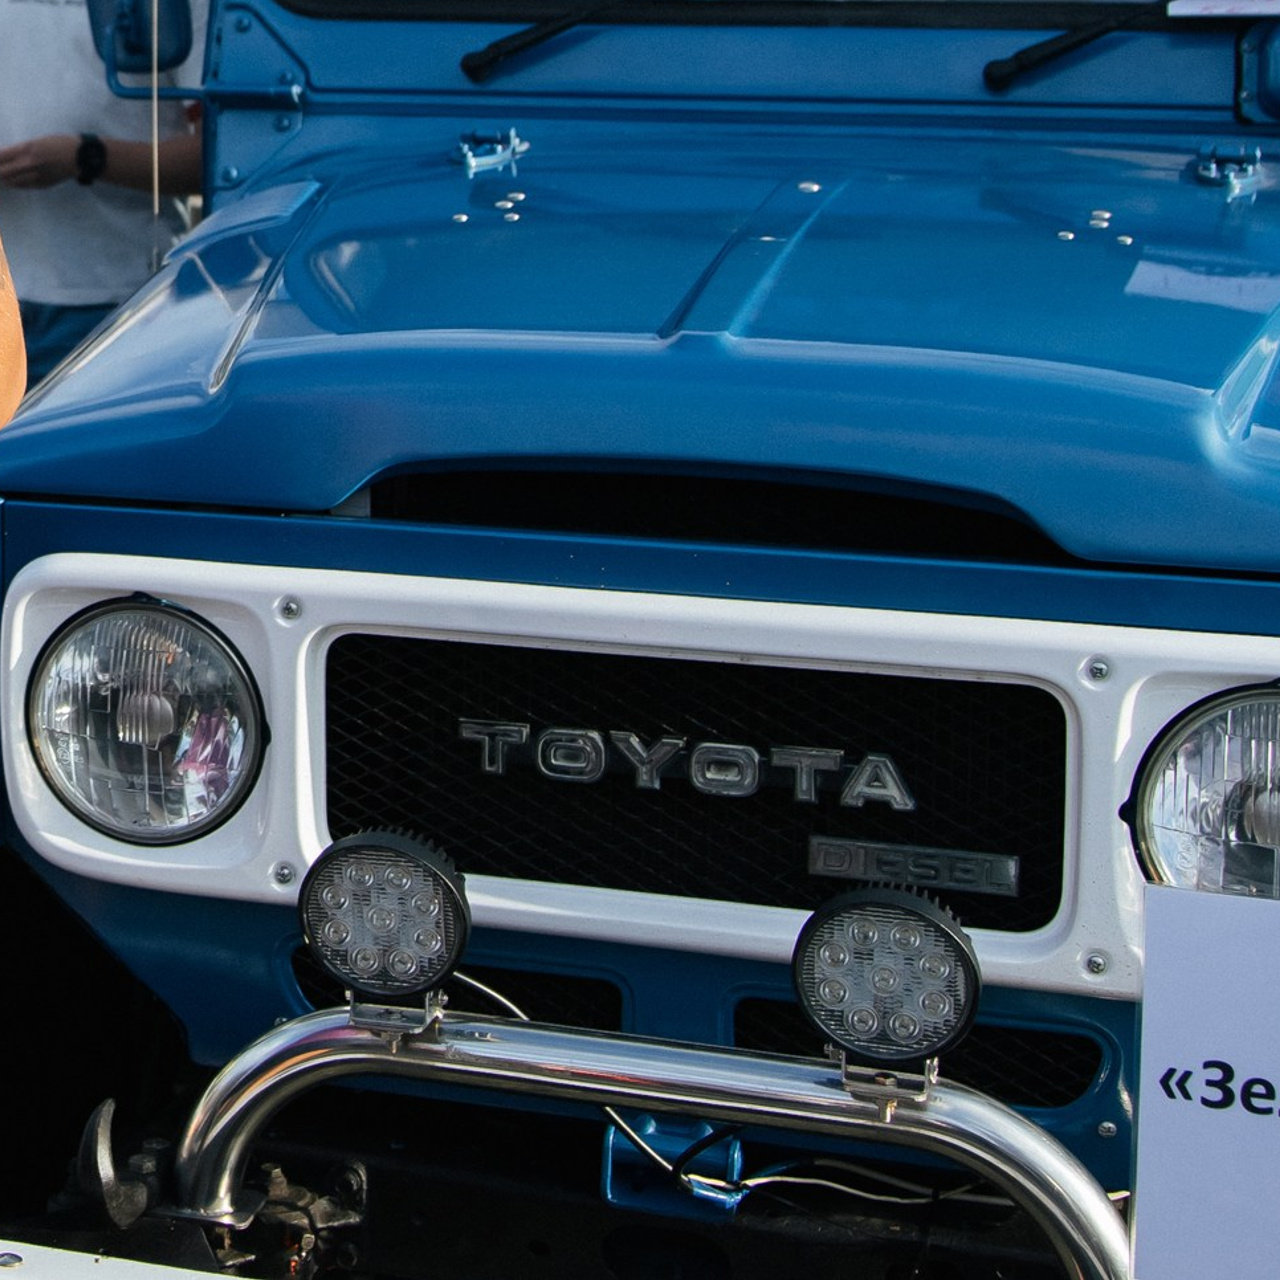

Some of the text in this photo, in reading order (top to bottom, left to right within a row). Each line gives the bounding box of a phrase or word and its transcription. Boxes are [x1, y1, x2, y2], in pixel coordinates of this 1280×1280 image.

[458, 717, 917, 813] TOYOTA
[815, 839, 1015, 894] DIESEL
[1158, 1059, 1280, 1116] «Зе
